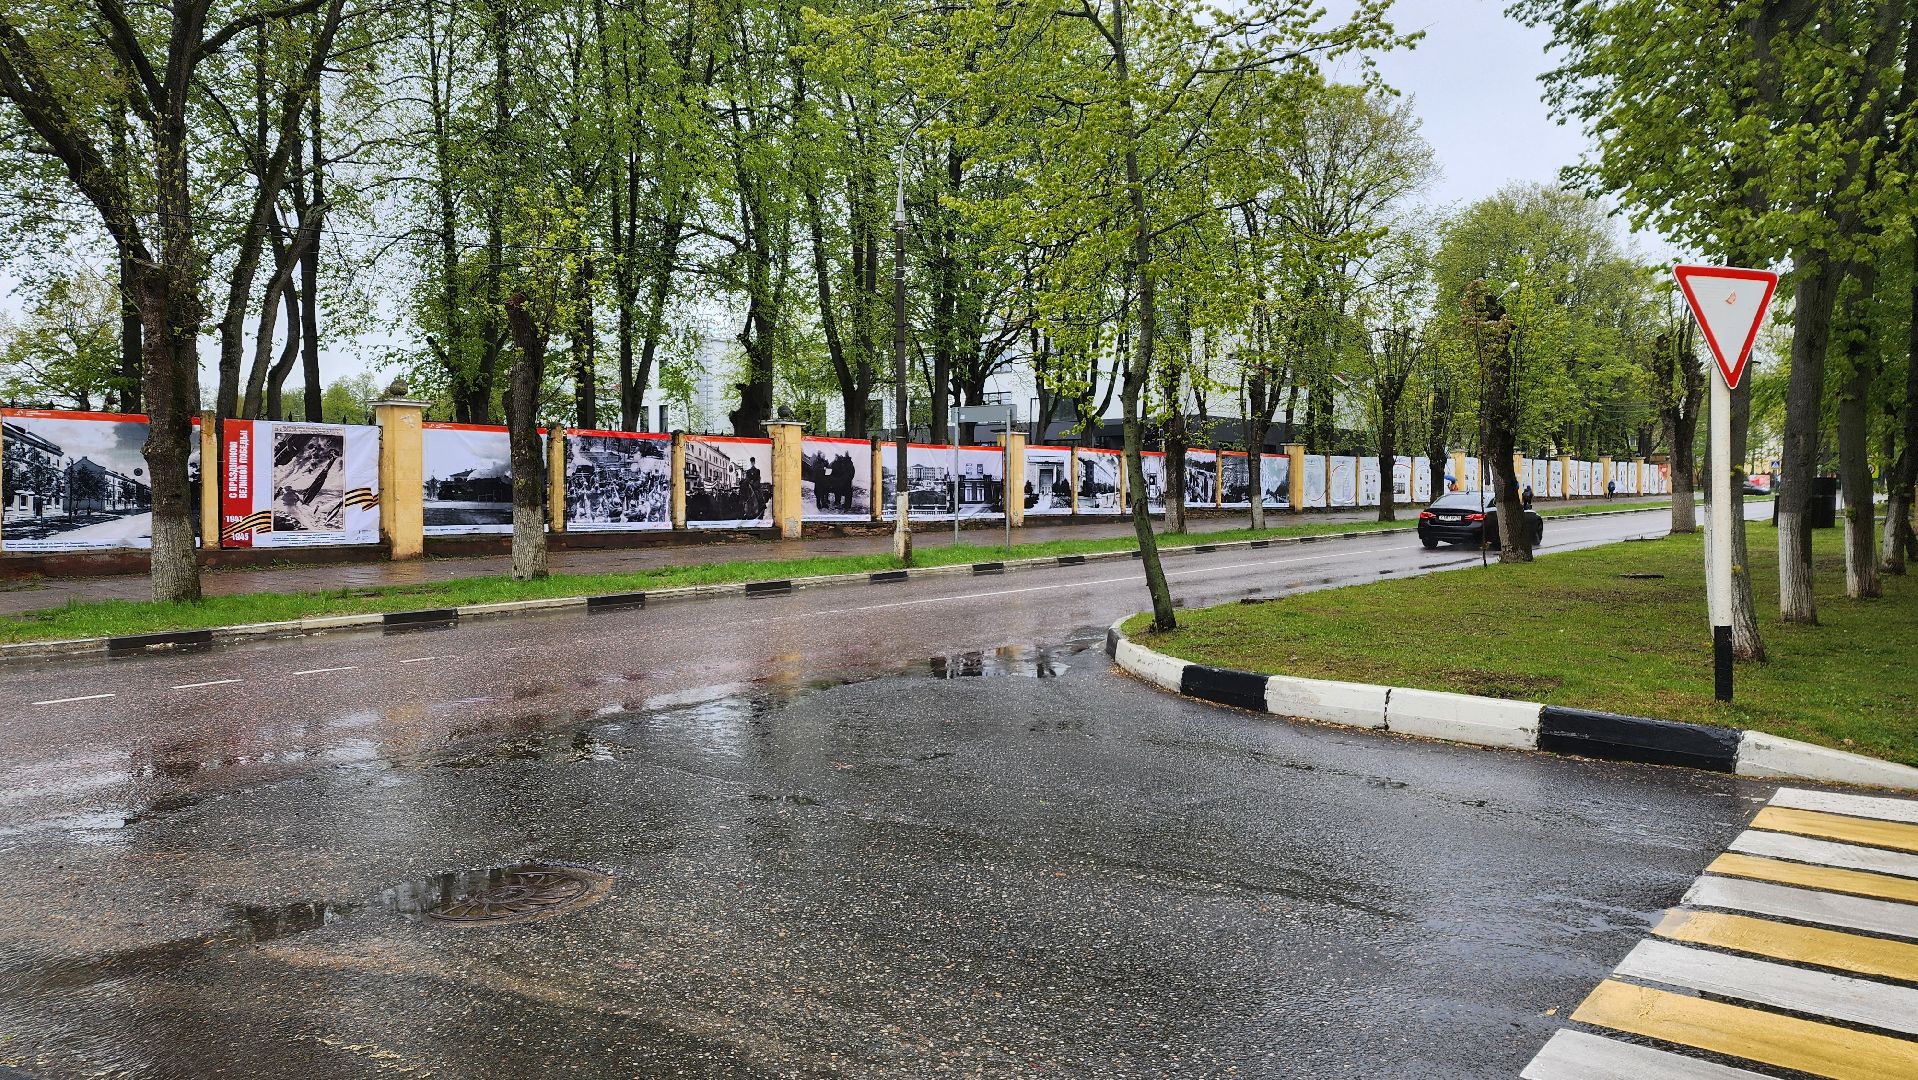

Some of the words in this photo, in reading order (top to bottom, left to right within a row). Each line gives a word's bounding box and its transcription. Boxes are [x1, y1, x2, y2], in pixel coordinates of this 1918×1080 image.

[229, 441, 238, 491] ПРАЗДНИКОМ
[238, 465, 248, 499] ВЕЛИКОЙ
[225, 515, 243, 523] 1941
[232, 532, 249, 541] 1945
